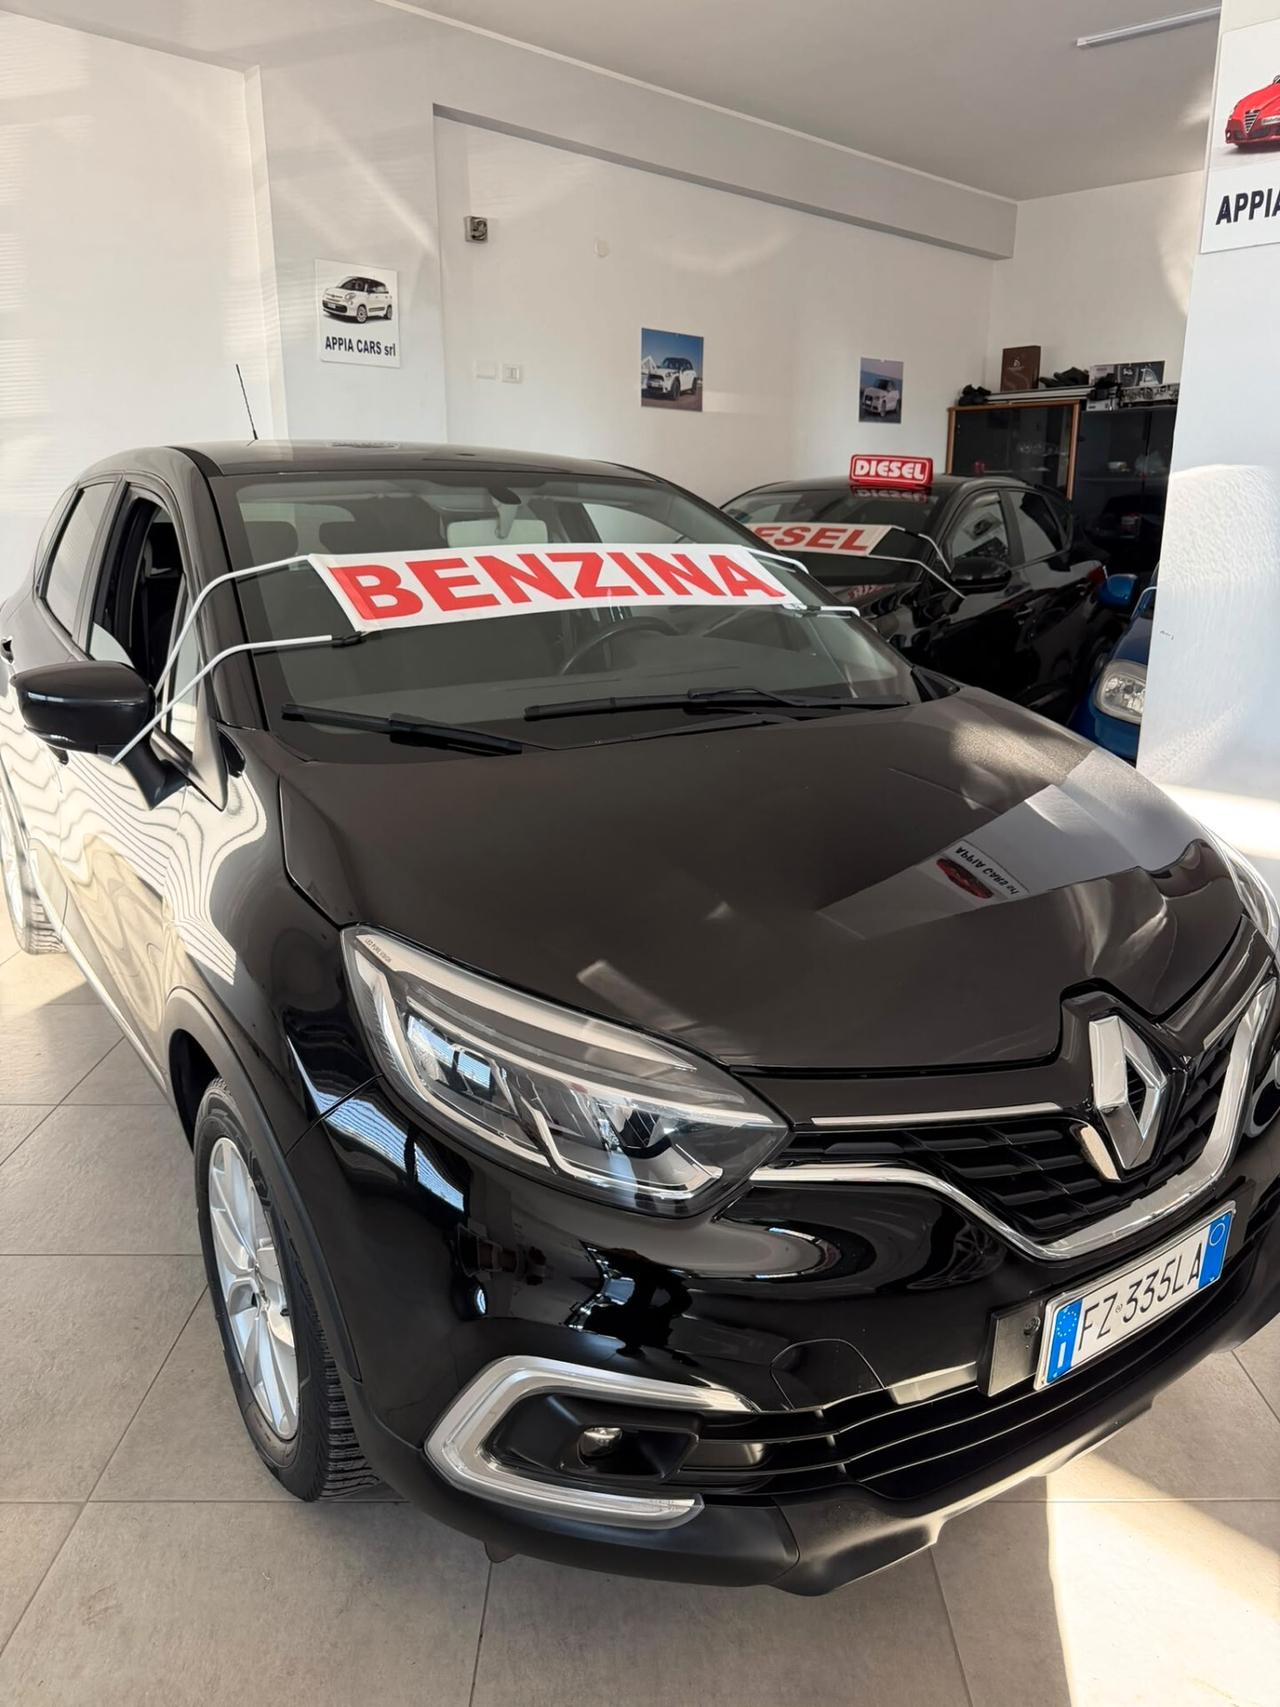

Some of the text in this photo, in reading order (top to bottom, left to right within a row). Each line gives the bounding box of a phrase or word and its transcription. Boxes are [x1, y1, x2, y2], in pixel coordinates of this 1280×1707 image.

[325, 336, 396, 357] APPIA CARS srl
[854, 459, 925, 480] DIESEL
[328, 551, 786, 620] BENZINA
[1078, 1292, 1118, 1351] FZ
[1122, 1242, 1203, 1323] 335LA
